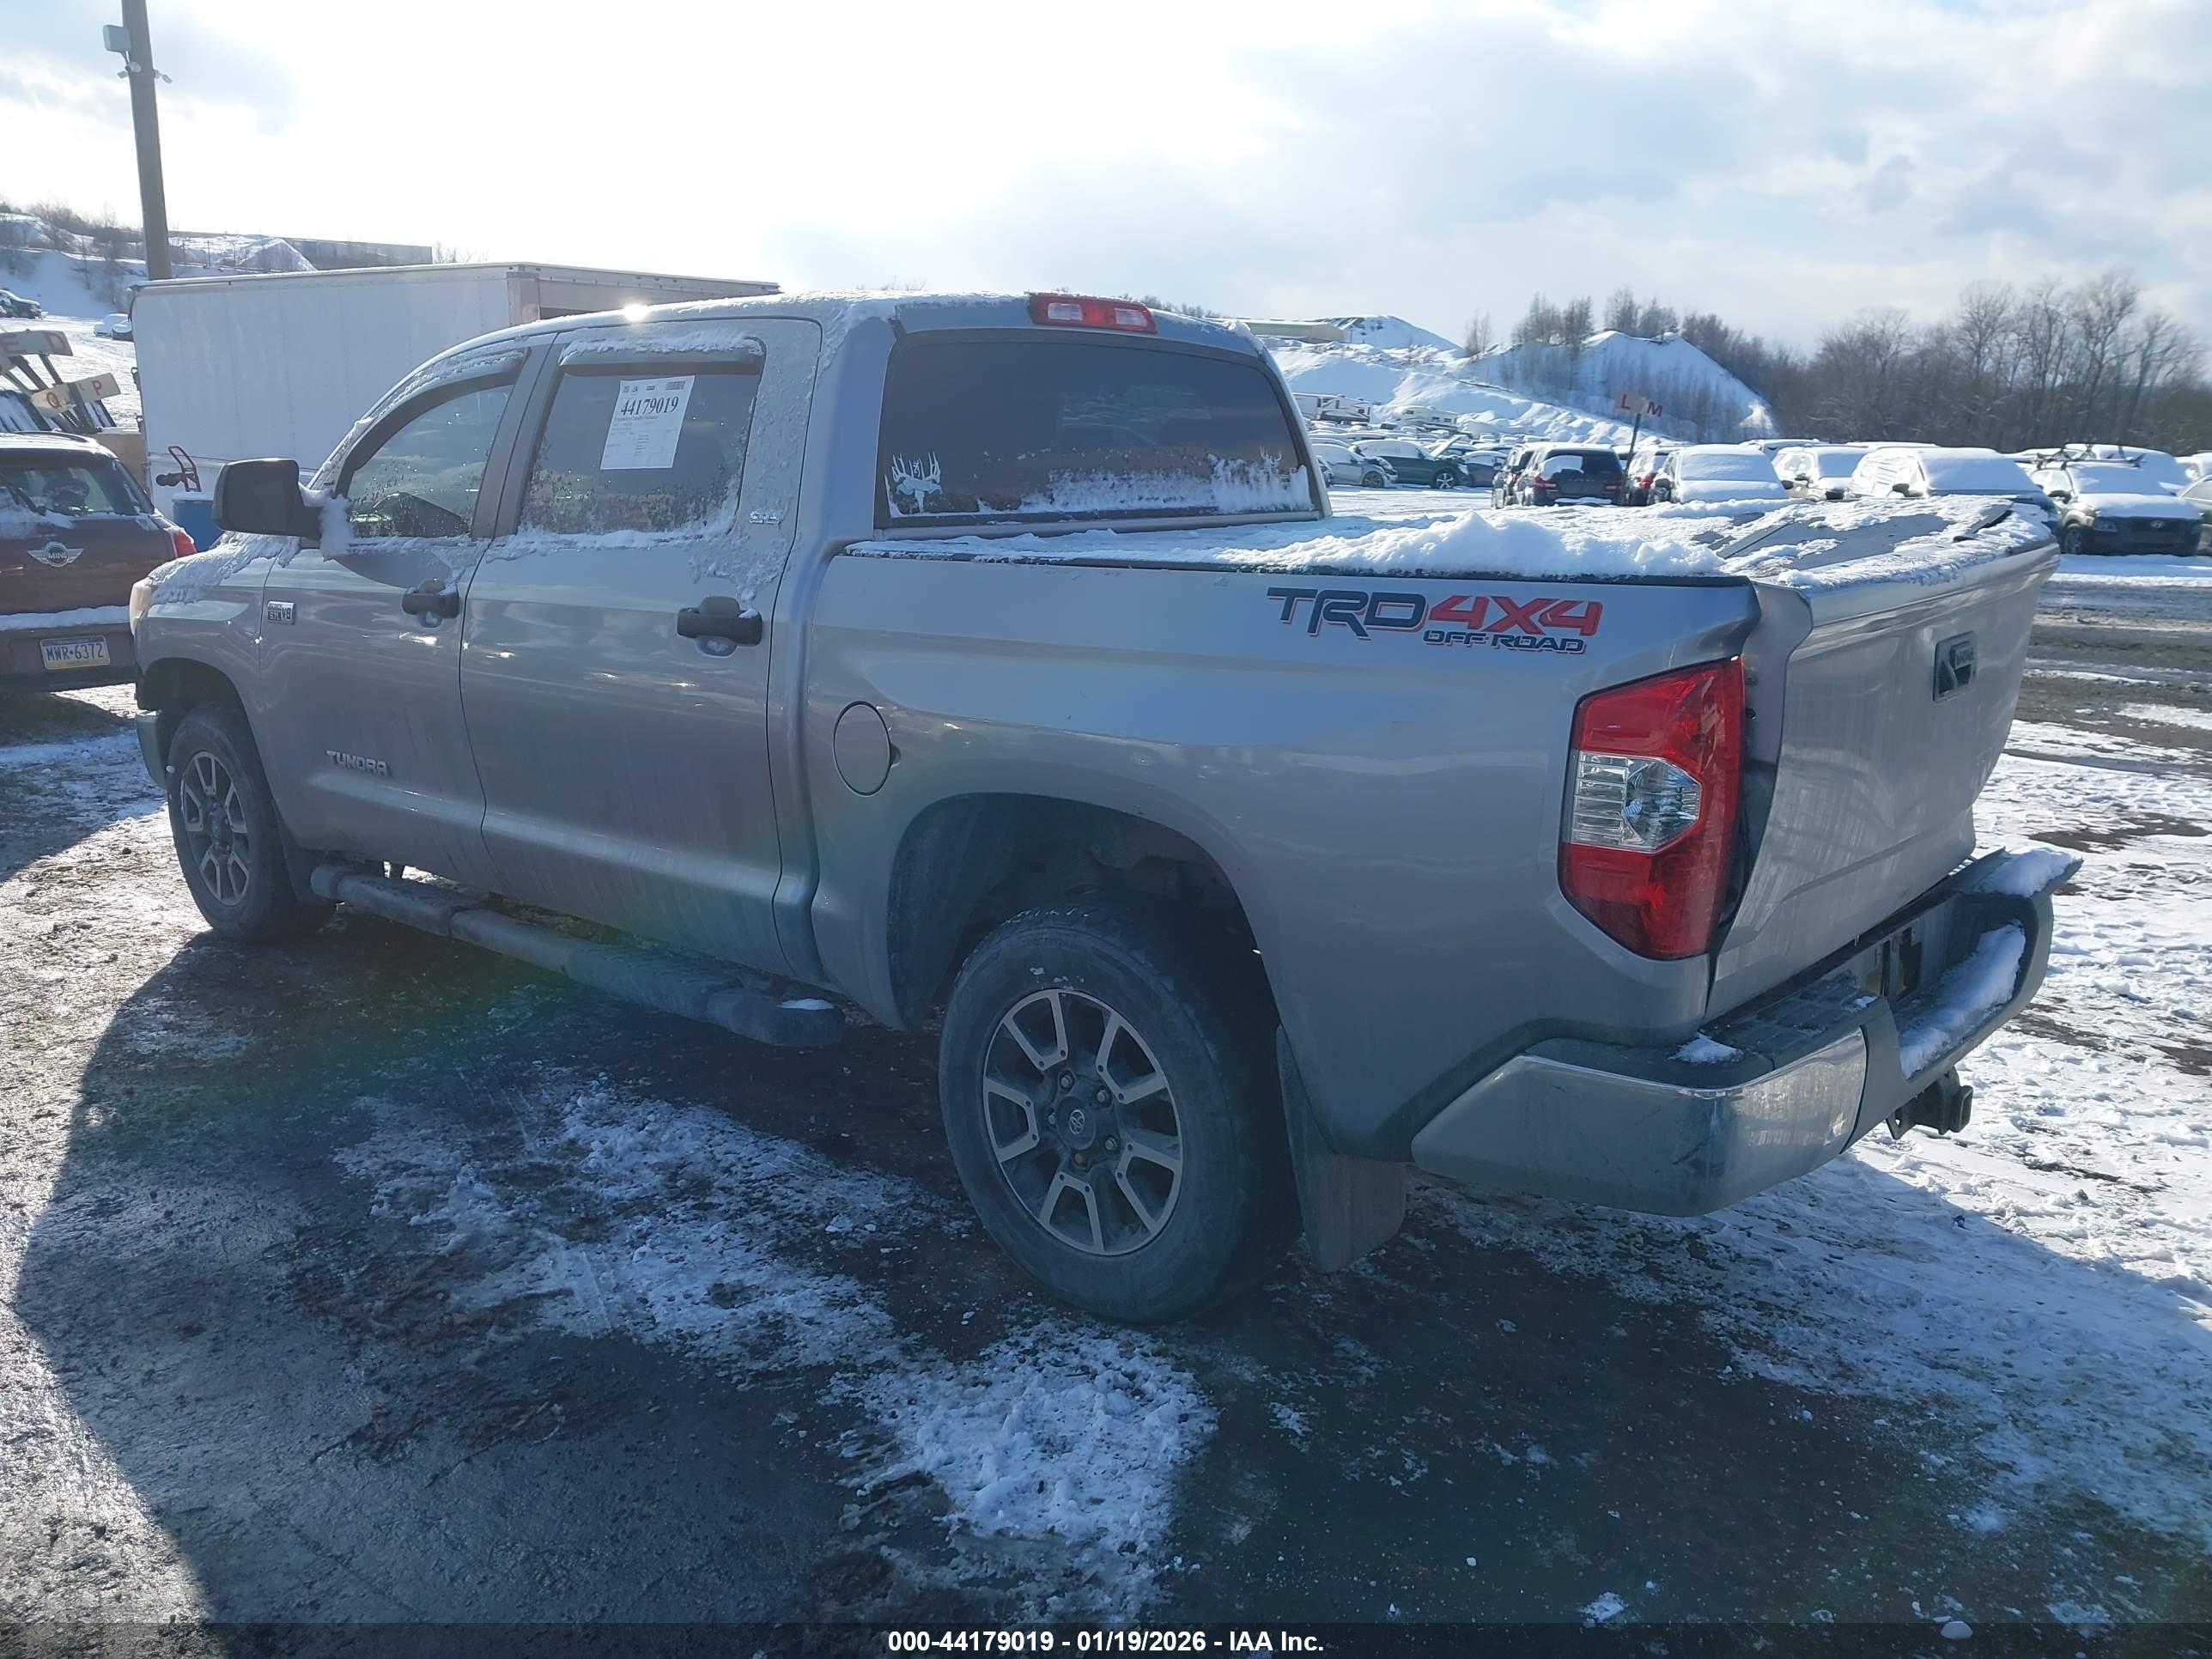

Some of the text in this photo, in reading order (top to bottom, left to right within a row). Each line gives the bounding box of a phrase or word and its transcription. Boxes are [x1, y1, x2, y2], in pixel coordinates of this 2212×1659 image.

[42, 331, 68, 355] D
[91, 380, 103, 396] P
[620, 396, 680, 416] 44179019
[1621, 393, 1663, 417] L M
[282, 606, 292, 619] V8
[1266, 586, 1428, 641] TRD
[1423, 629, 1587, 654] OFF ROAD
[326, 750, 387, 776] TUNDRA
